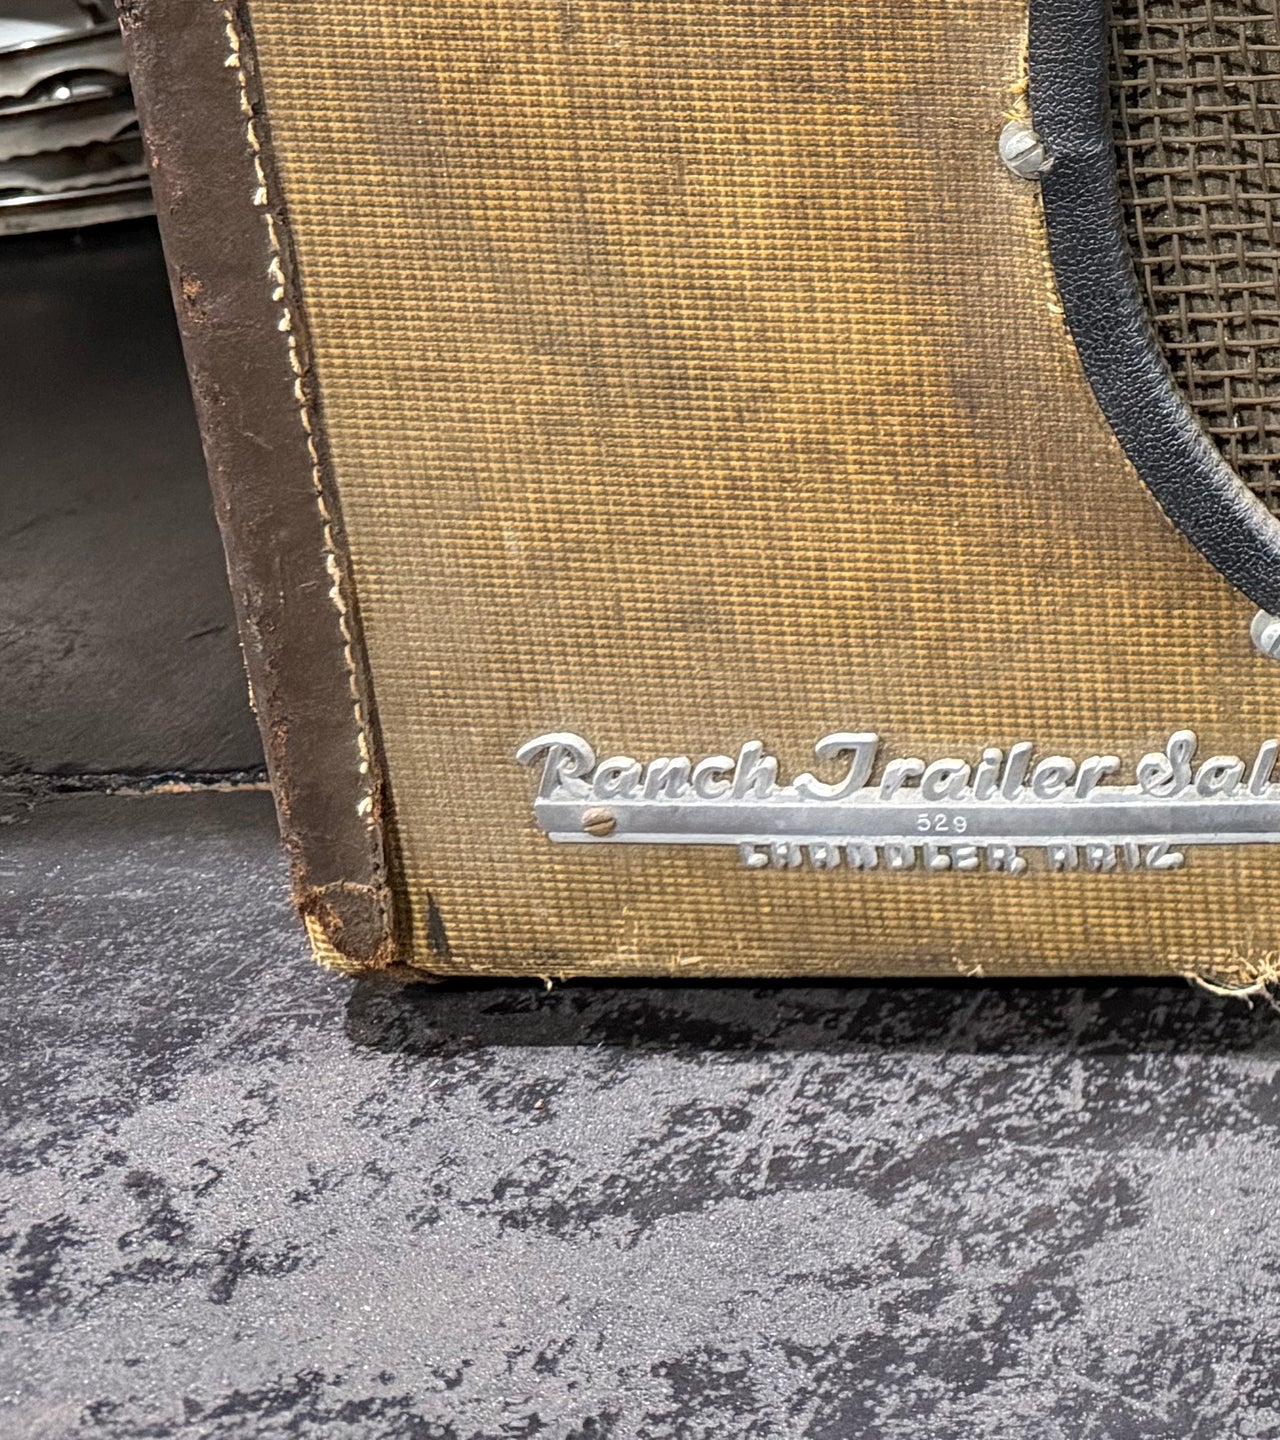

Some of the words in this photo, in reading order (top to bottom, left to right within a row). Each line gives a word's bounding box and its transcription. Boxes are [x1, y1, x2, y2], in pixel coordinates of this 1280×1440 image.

[515, 731, 779, 800] Ranch
[793, 731, 1120, 801] Trailer
[917, 812, 967, 834] 529
